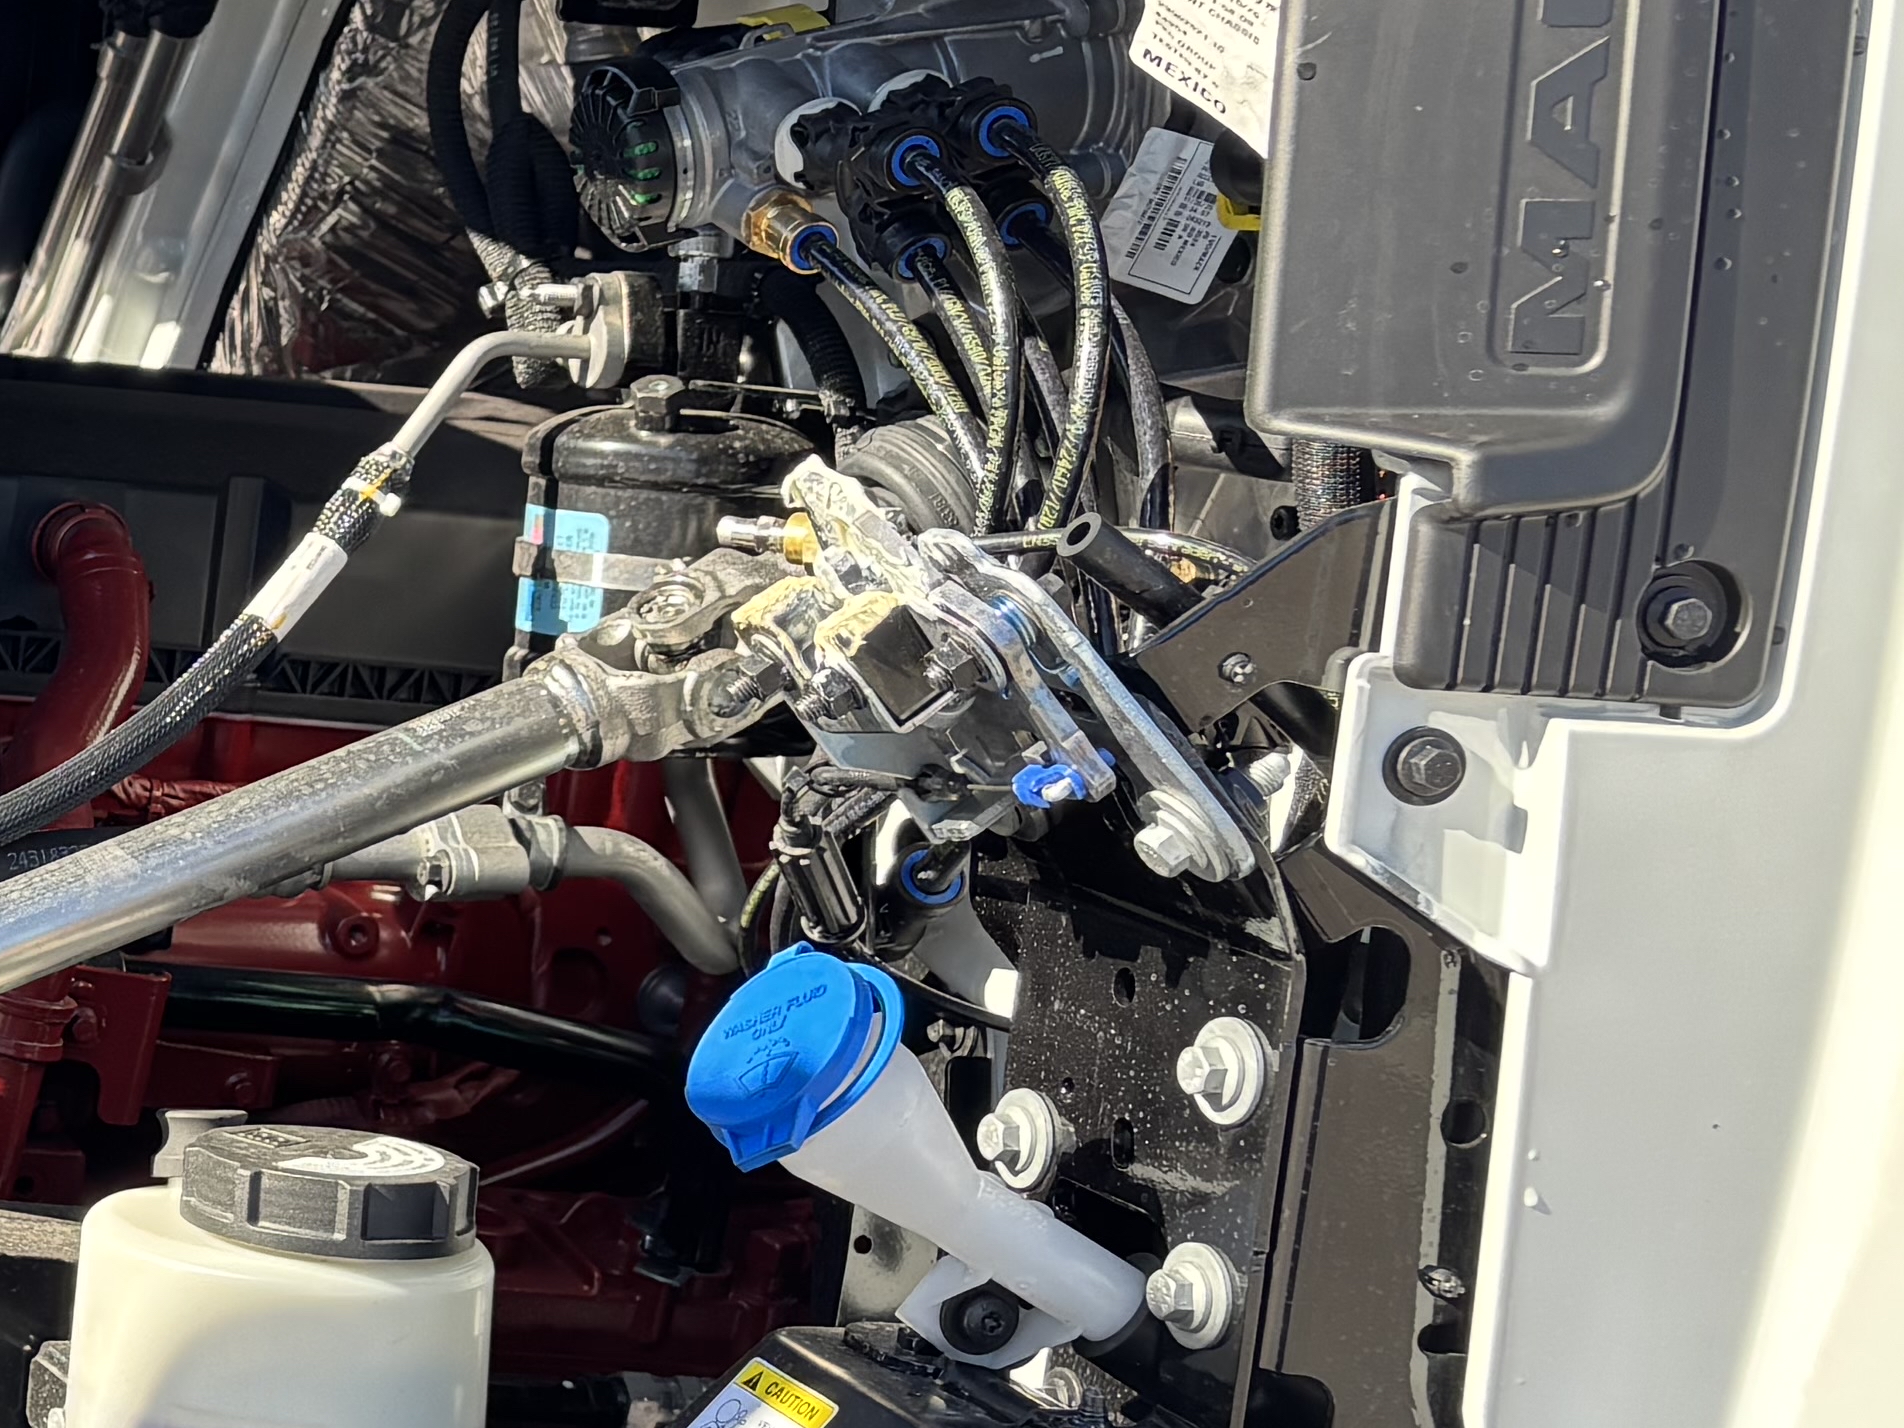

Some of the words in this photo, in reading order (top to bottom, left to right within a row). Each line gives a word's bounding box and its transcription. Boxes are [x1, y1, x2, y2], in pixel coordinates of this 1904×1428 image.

[1143, 48, 1226, 115] MEXICO
[723, 1005, 782, 1040] WASHER
[786, 984, 828, 1013] FLUID
[752, 1015, 787, 1041] ONLY
[764, 1381, 820, 1422] CAUTION
